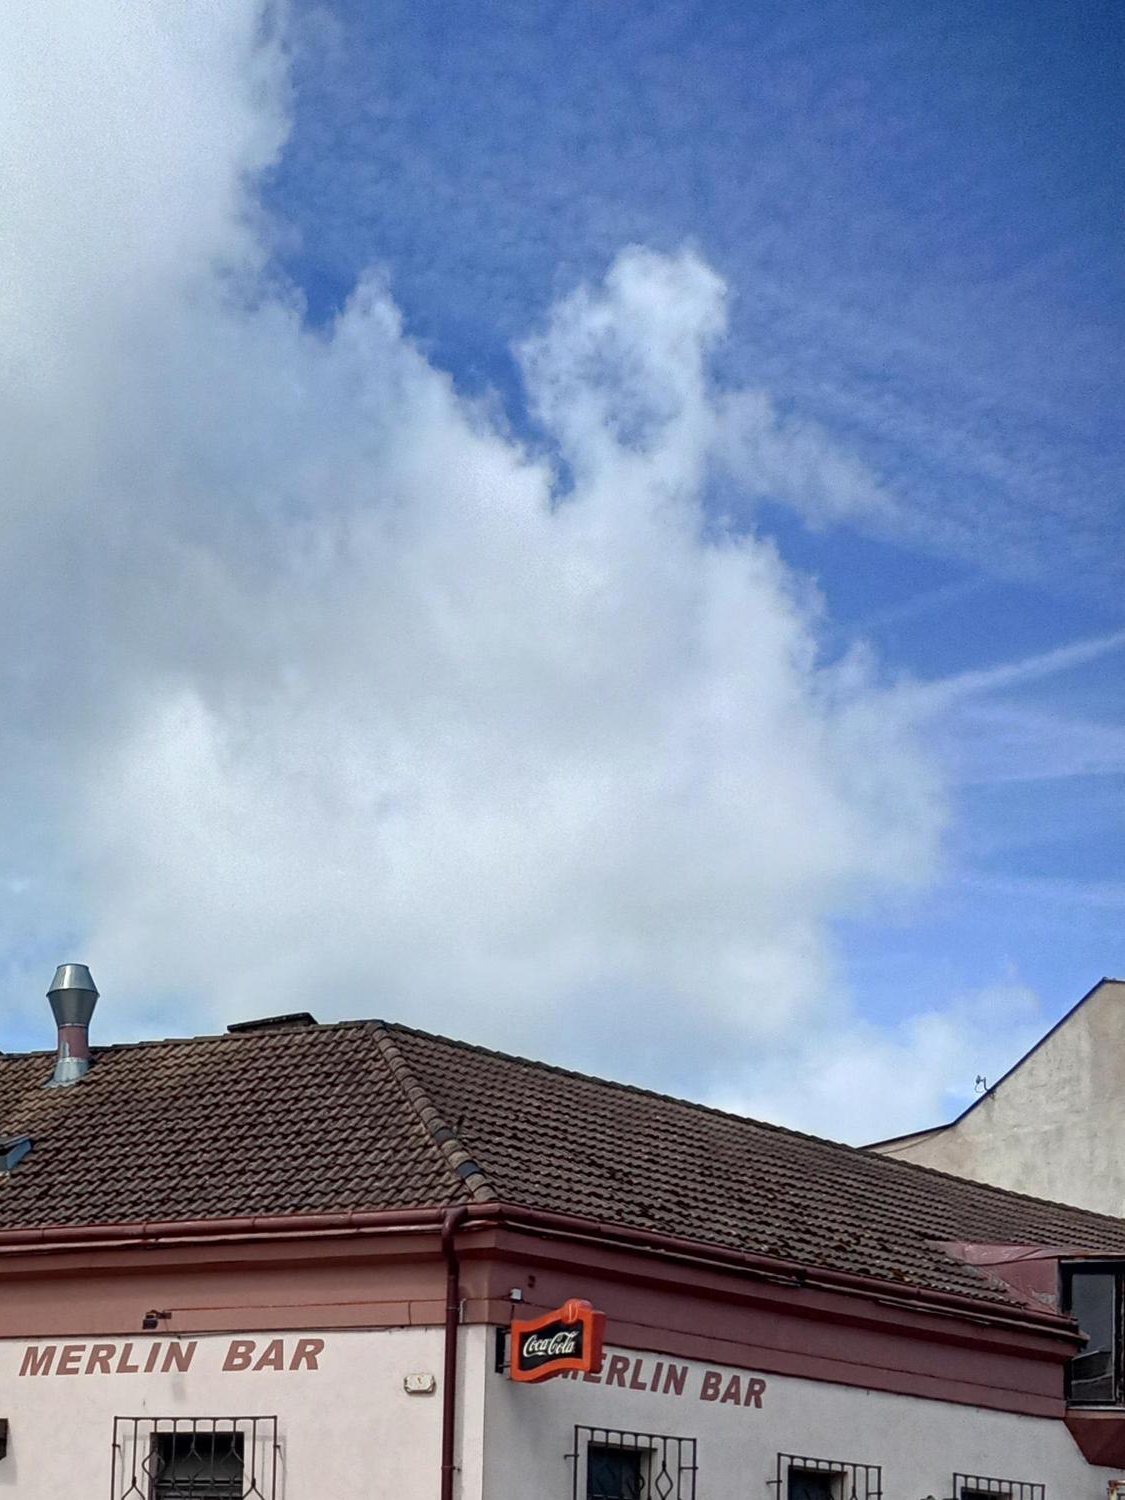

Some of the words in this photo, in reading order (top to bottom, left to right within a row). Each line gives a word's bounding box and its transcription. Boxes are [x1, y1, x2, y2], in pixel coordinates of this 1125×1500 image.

[18, 1341, 198, 1377] MERLIN
[222, 1338, 325, 1373] BAR
[523, 1331, 579, 1358] Coca-Cola
[555, 1353, 689, 1396] RLIN
[699, 1371, 767, 1409] BAR
